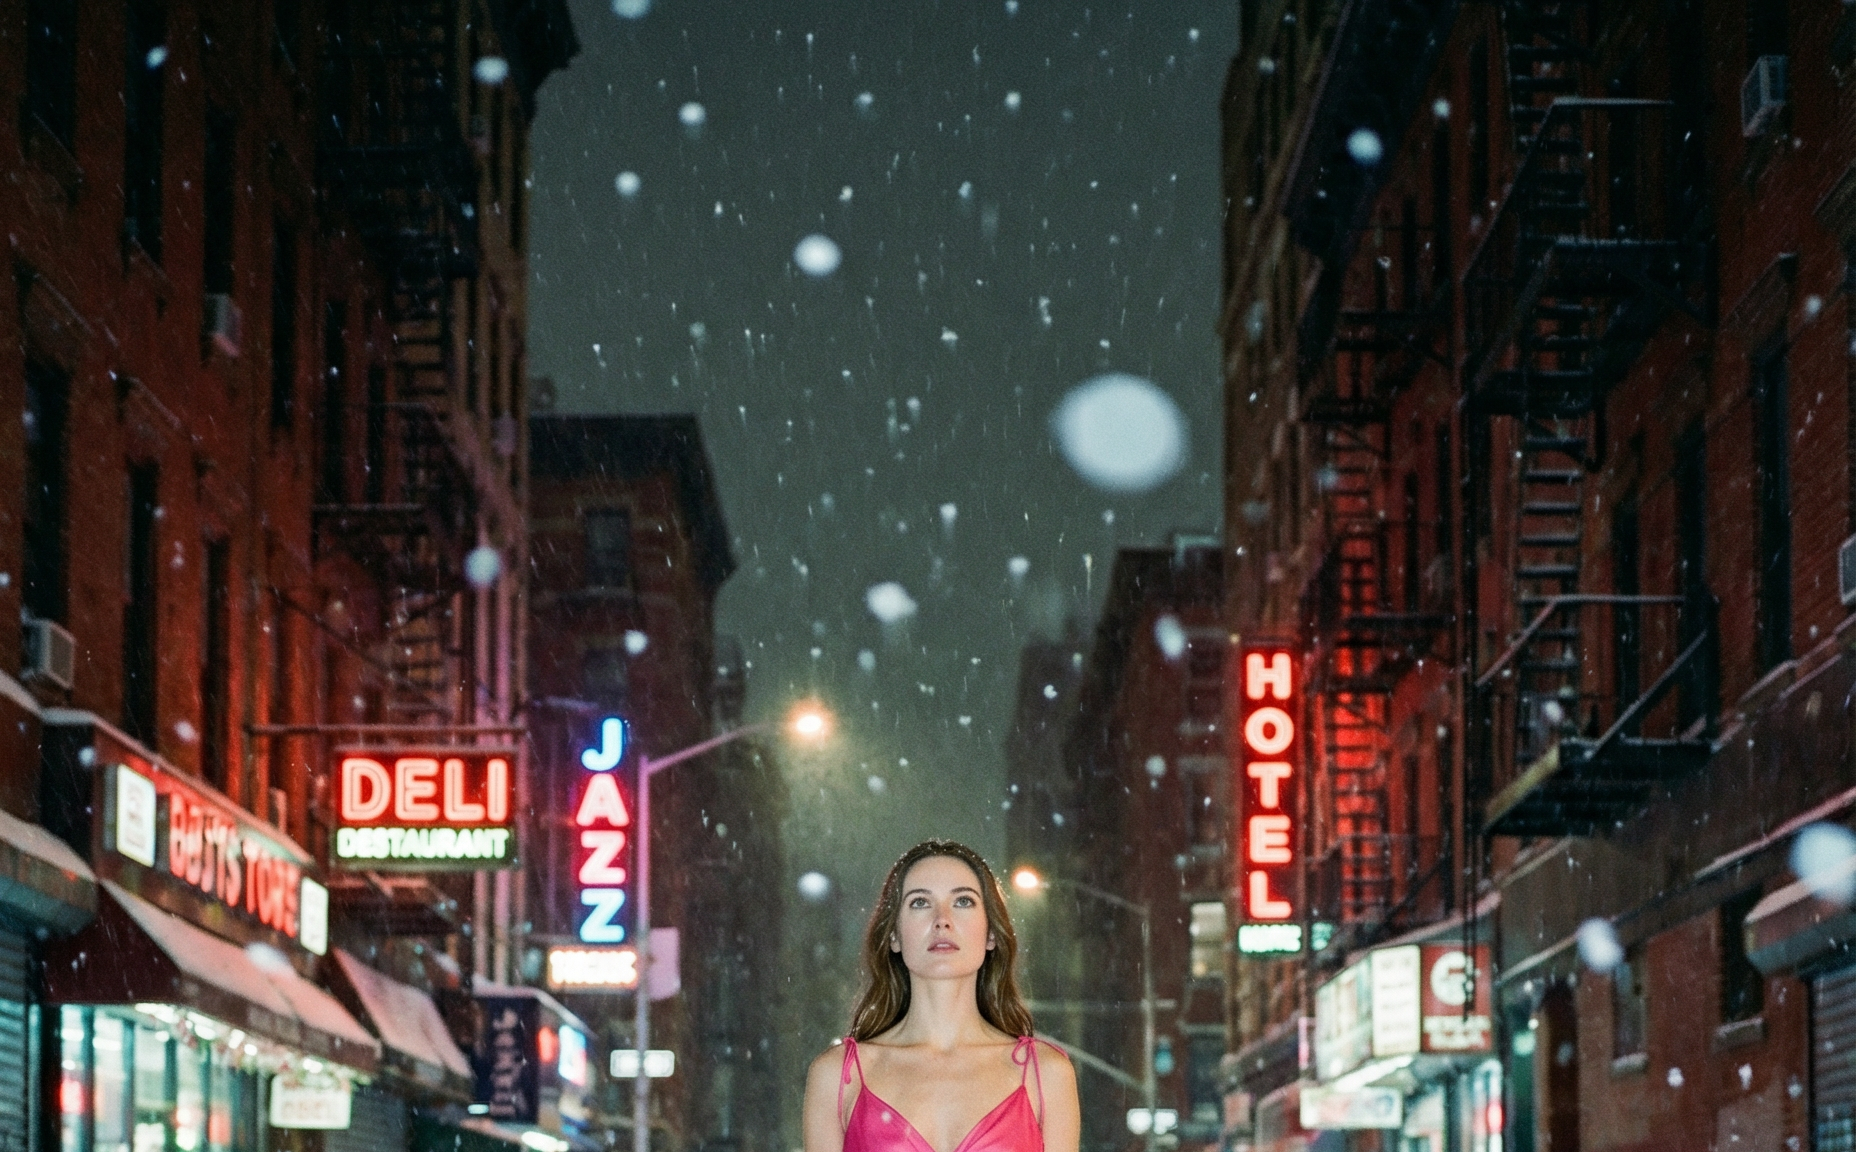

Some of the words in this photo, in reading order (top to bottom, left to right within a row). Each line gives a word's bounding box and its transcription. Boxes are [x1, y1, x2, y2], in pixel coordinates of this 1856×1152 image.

[341, 758, 508, 822] DELI
[576, 717, 629, 942] JAZZ
[1245, 653, 1294, 919] HOTEL
